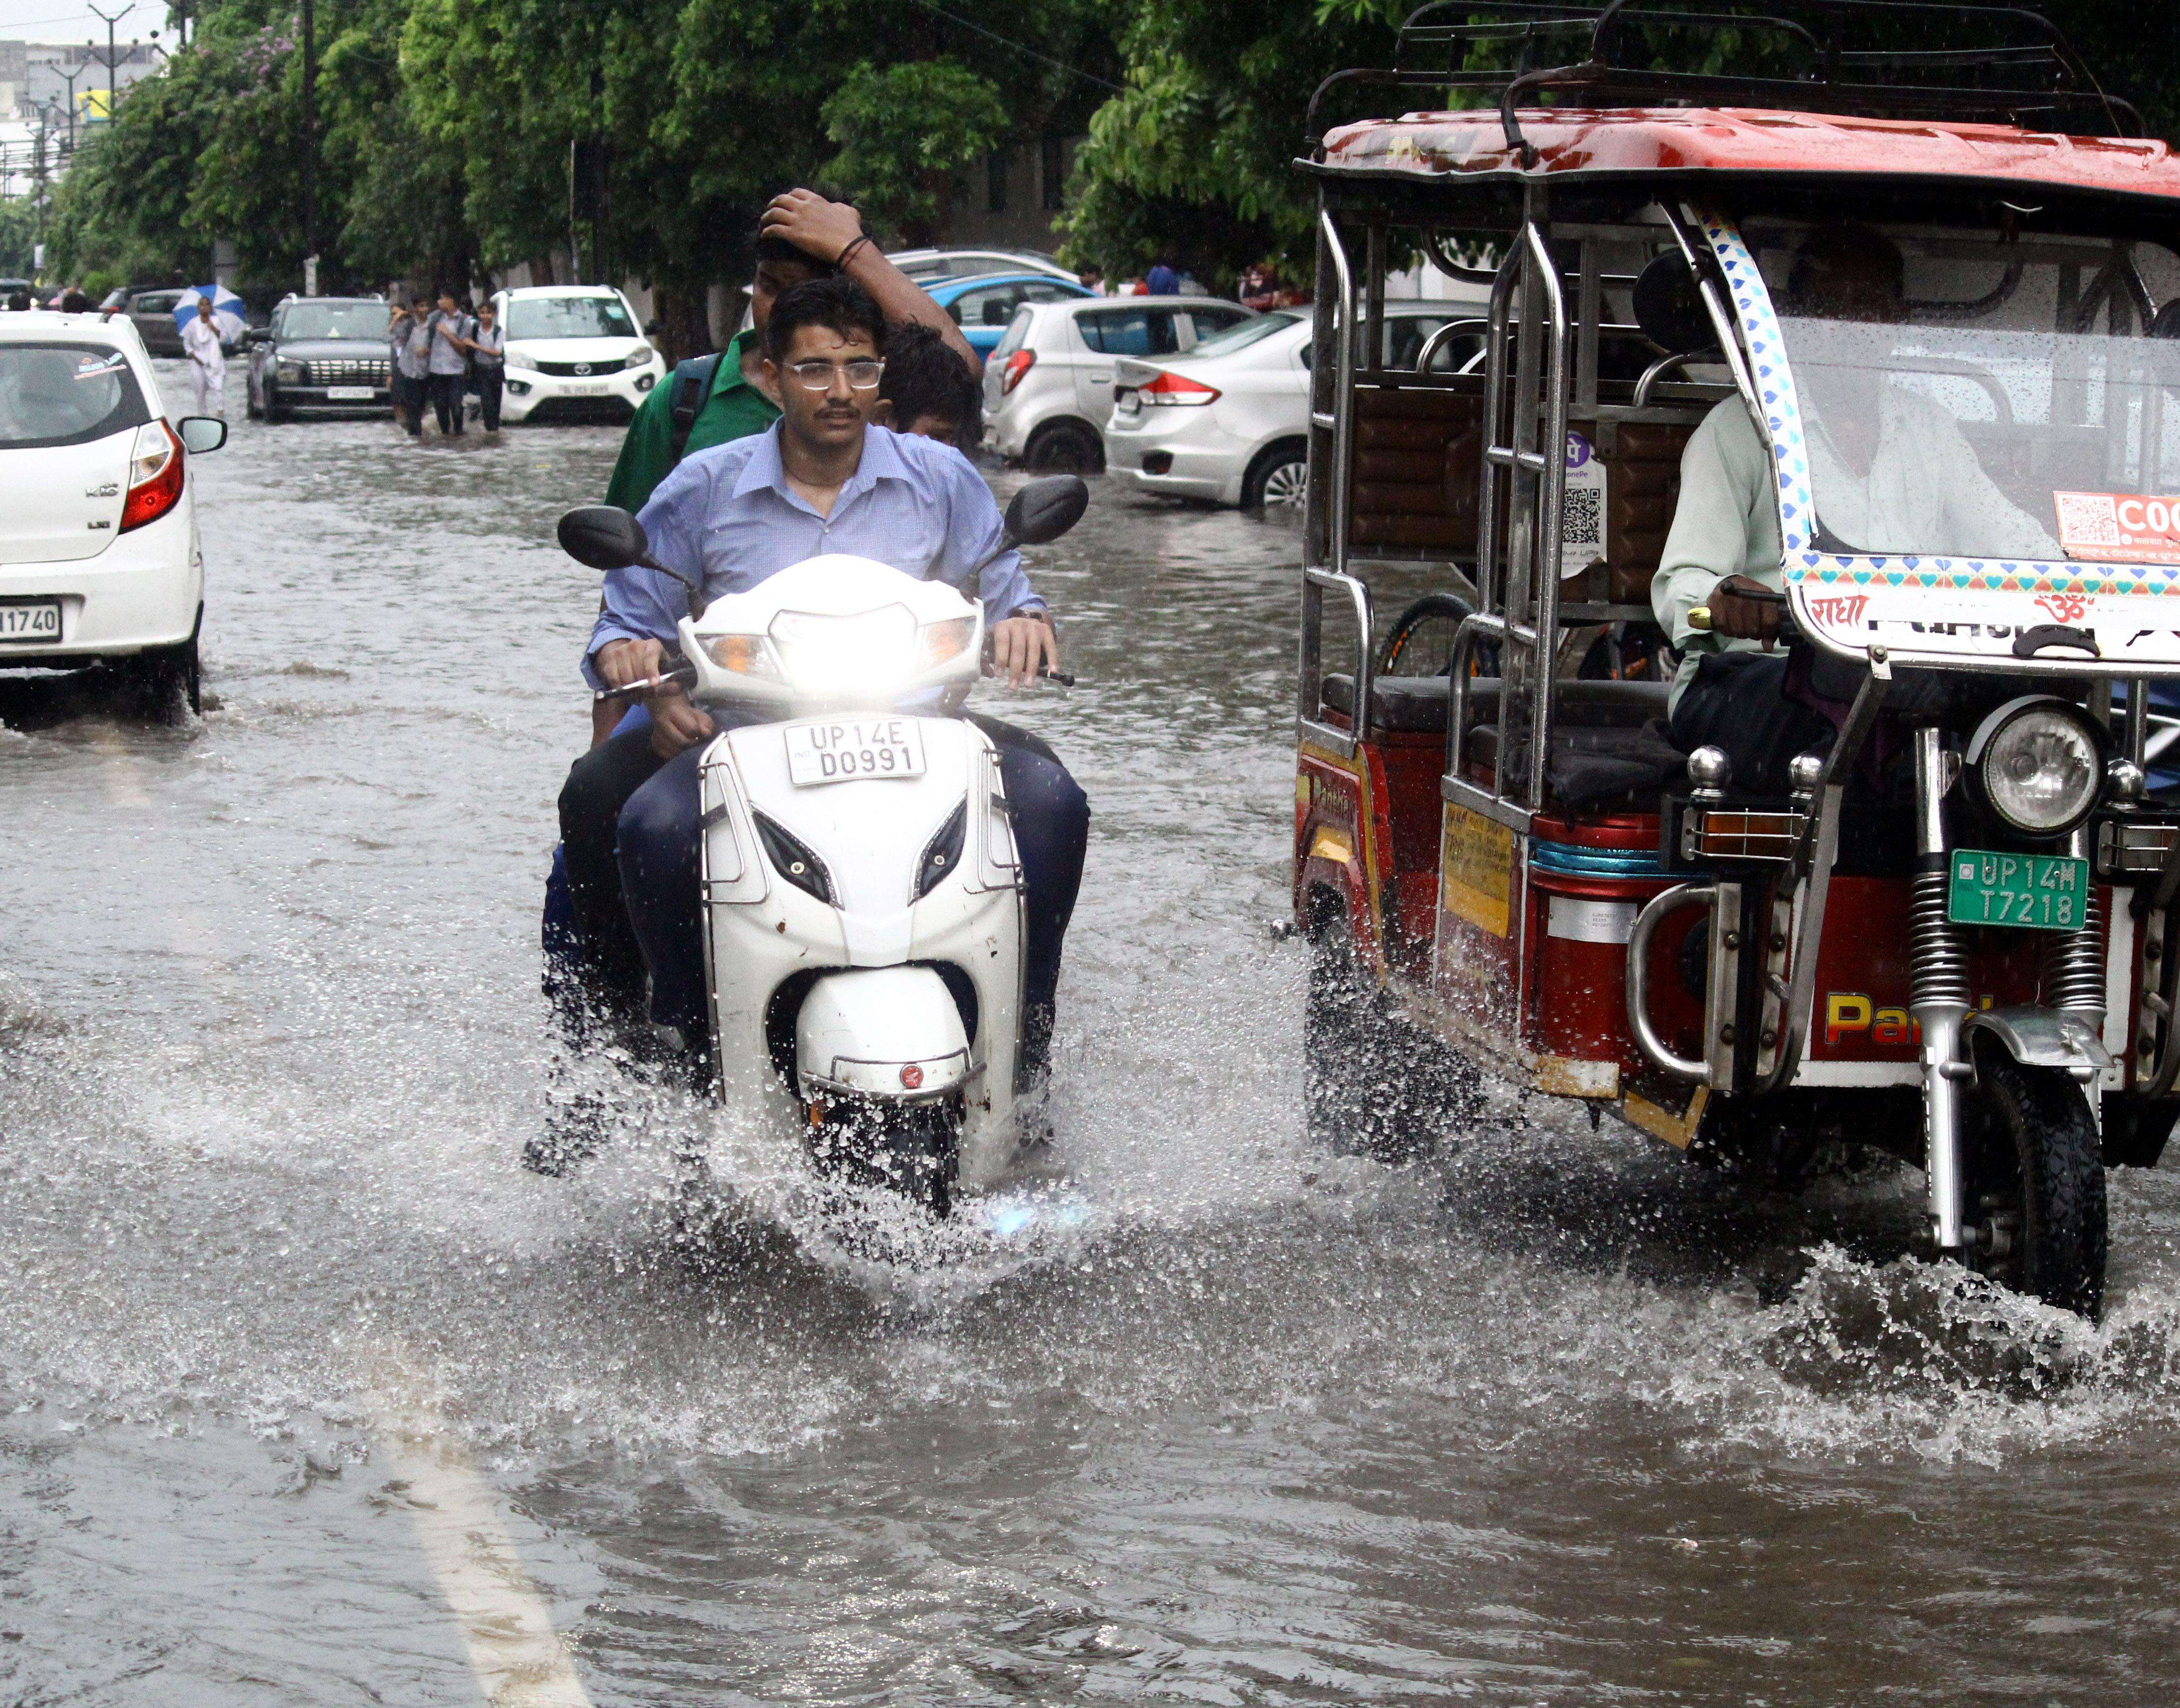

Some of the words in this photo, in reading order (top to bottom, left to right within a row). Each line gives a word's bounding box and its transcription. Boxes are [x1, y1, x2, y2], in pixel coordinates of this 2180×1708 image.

[1811, 595, 1870, 629] राधा
[821, 746, 912, 776] D0991
[1980, 890, 2073, 925] T7218
